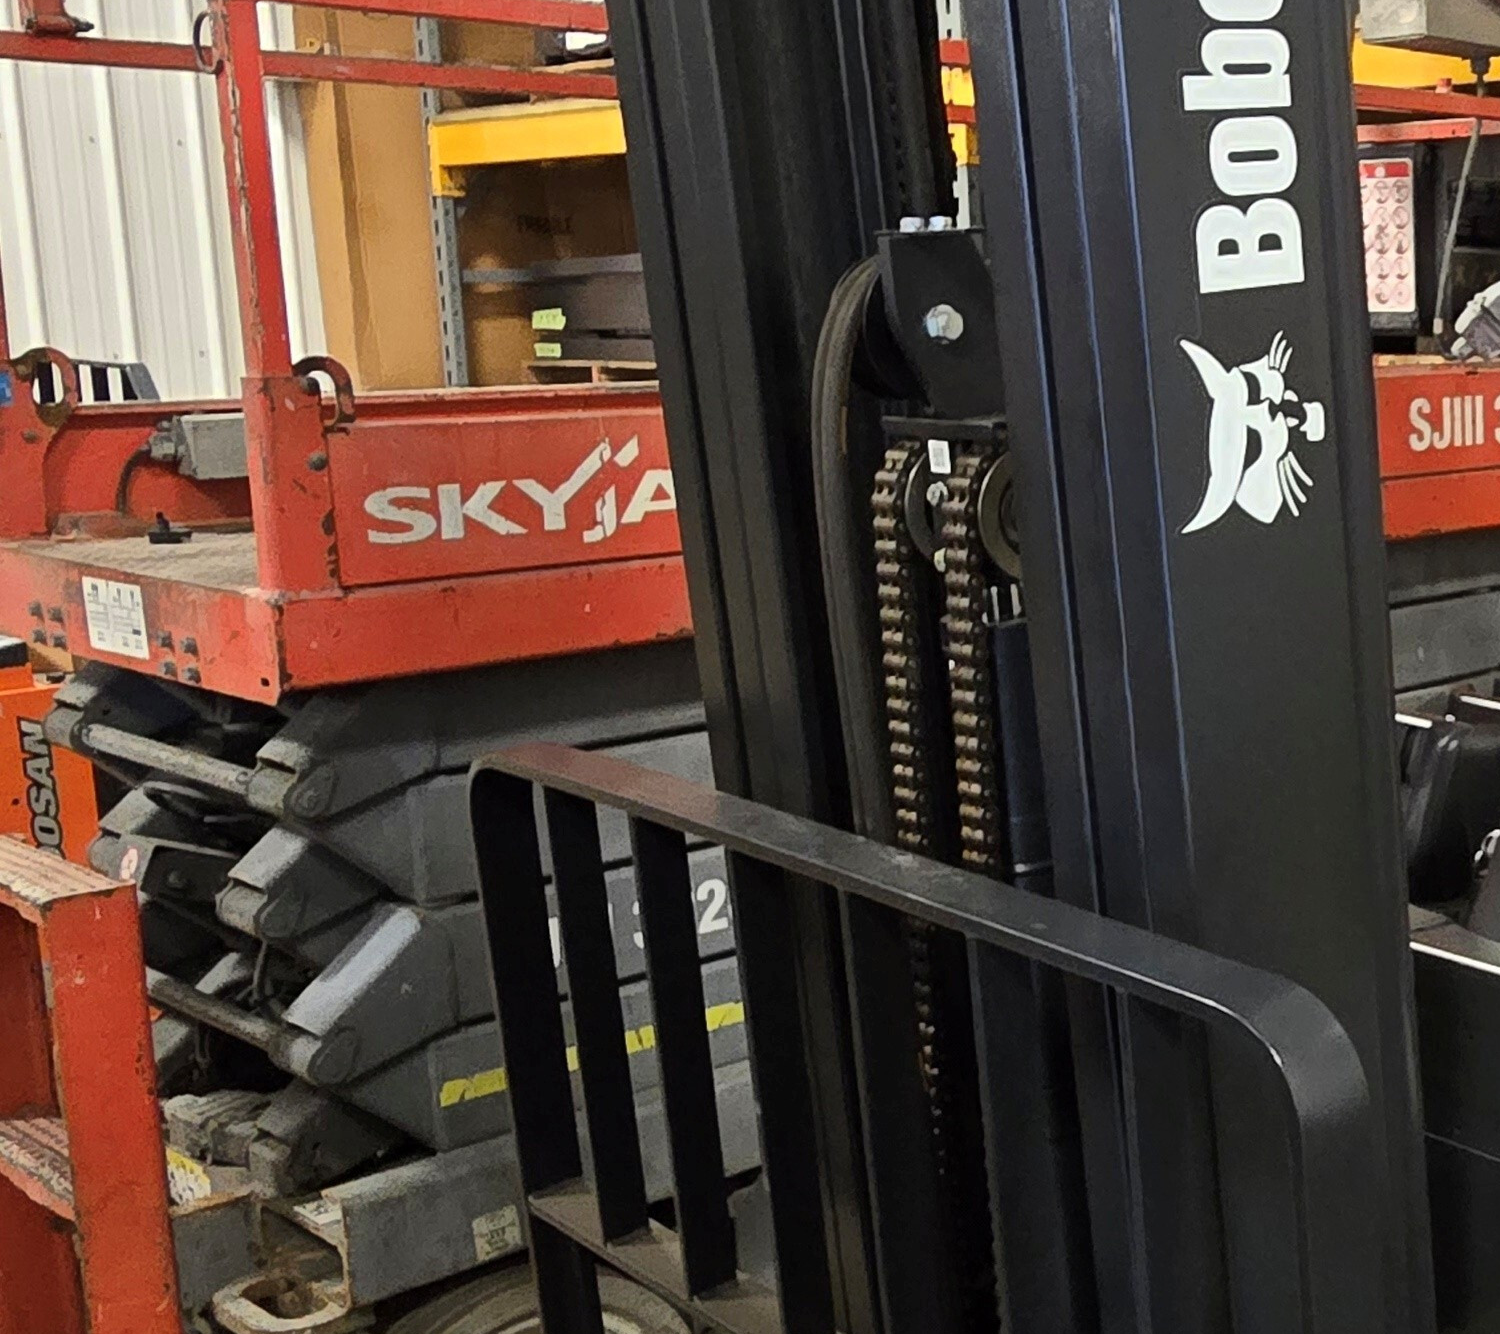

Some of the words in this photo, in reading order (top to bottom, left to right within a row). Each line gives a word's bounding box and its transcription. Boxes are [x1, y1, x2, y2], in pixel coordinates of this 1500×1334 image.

[1408, 395, 1486, 452] SJIII
[363, 434, 677, 544] SKYJA
[17, 716, 64, 854] OSAN
